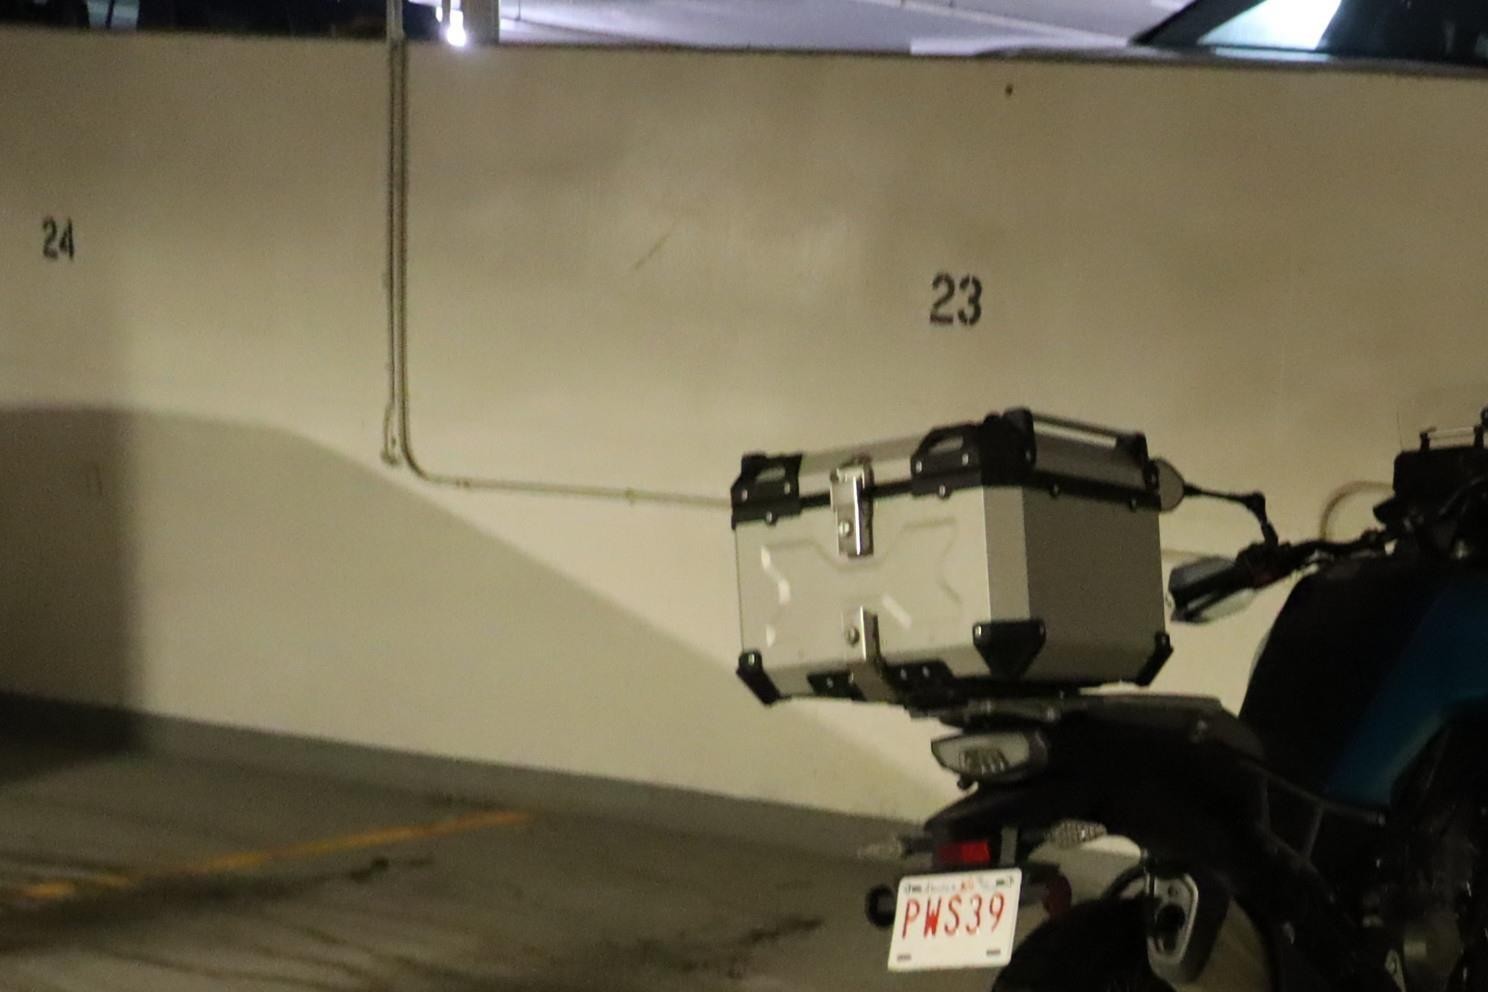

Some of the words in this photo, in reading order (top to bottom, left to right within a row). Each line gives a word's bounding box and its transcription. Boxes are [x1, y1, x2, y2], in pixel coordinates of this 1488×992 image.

[43, 216, 74, 260] 24
[930, 272, 982, 326] 23
[902, 891, 1005, 939] PWS39
